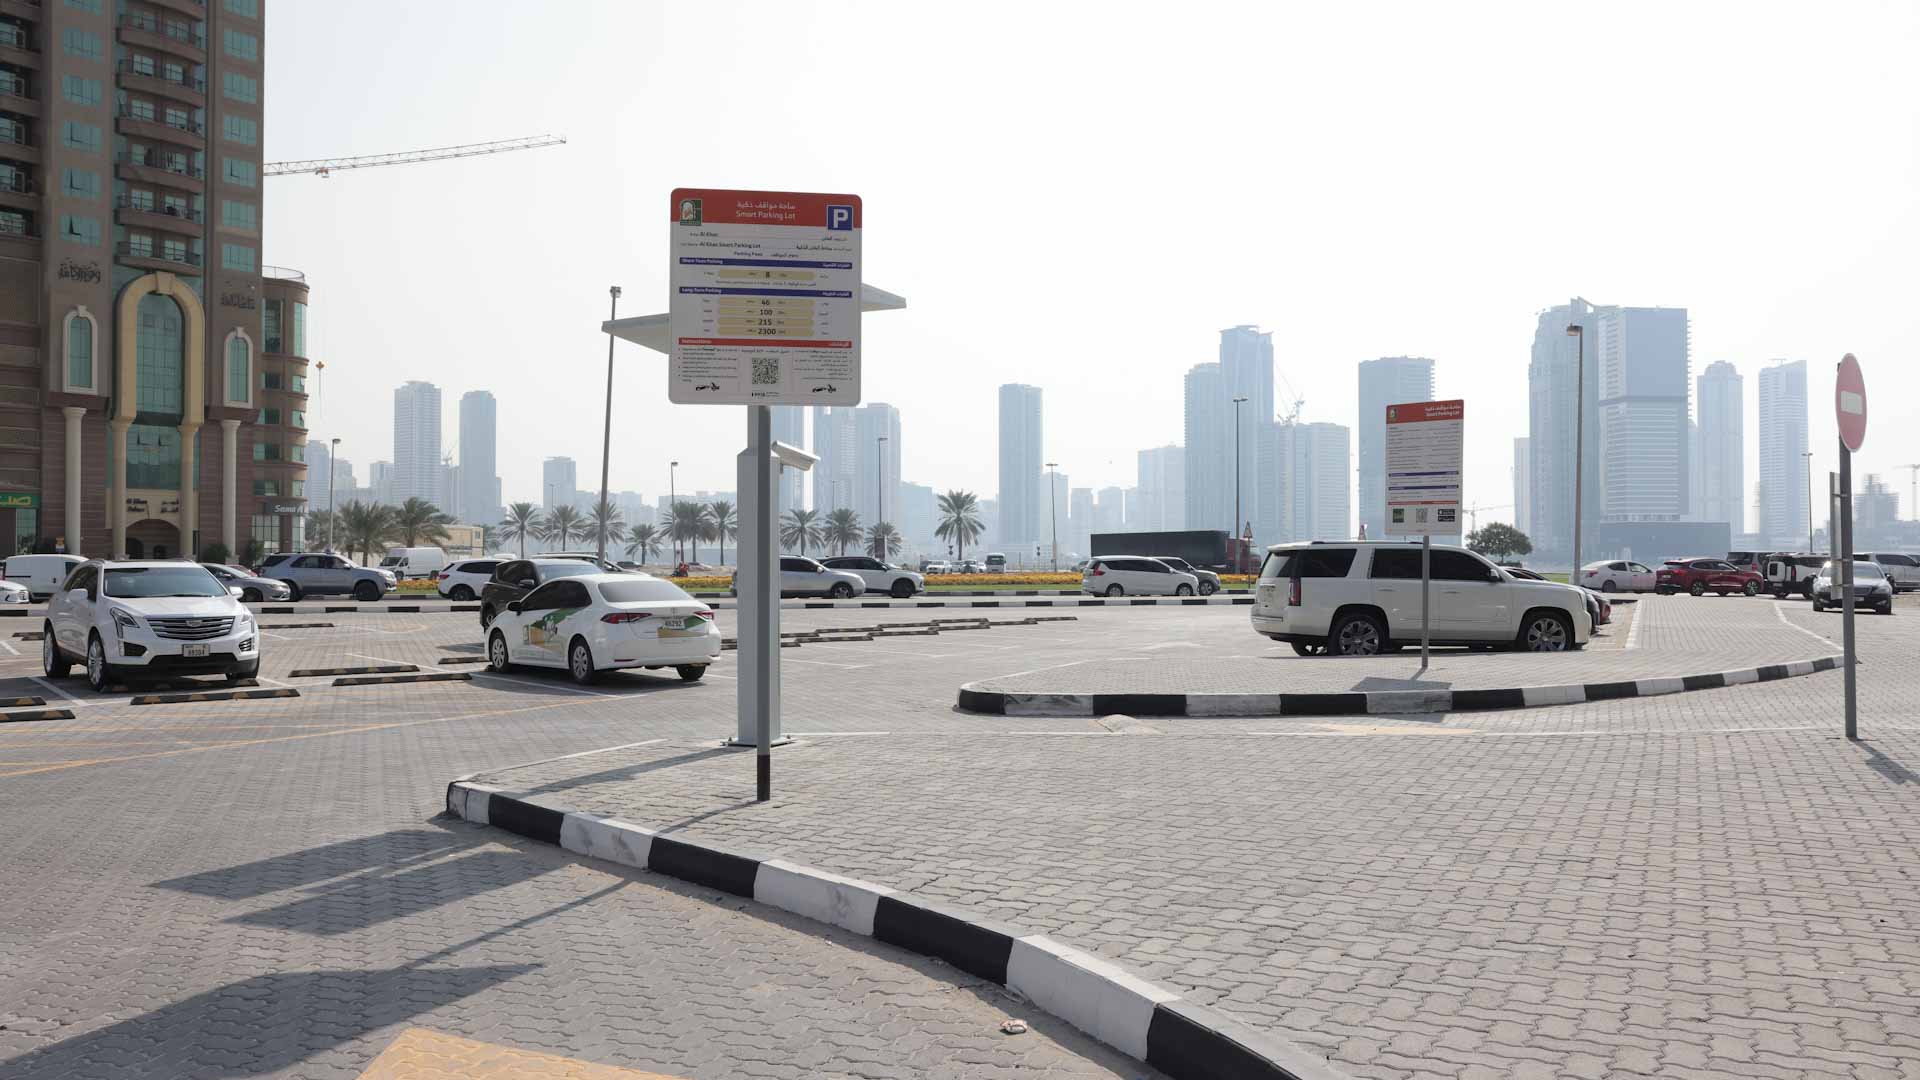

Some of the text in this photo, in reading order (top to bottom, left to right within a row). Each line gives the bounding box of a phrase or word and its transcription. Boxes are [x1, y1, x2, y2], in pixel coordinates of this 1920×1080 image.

[736, 210, 796, 221] Smart Parking Lot
[833, 208, 849, 229] P
[758, 318, 772, 326] 215
